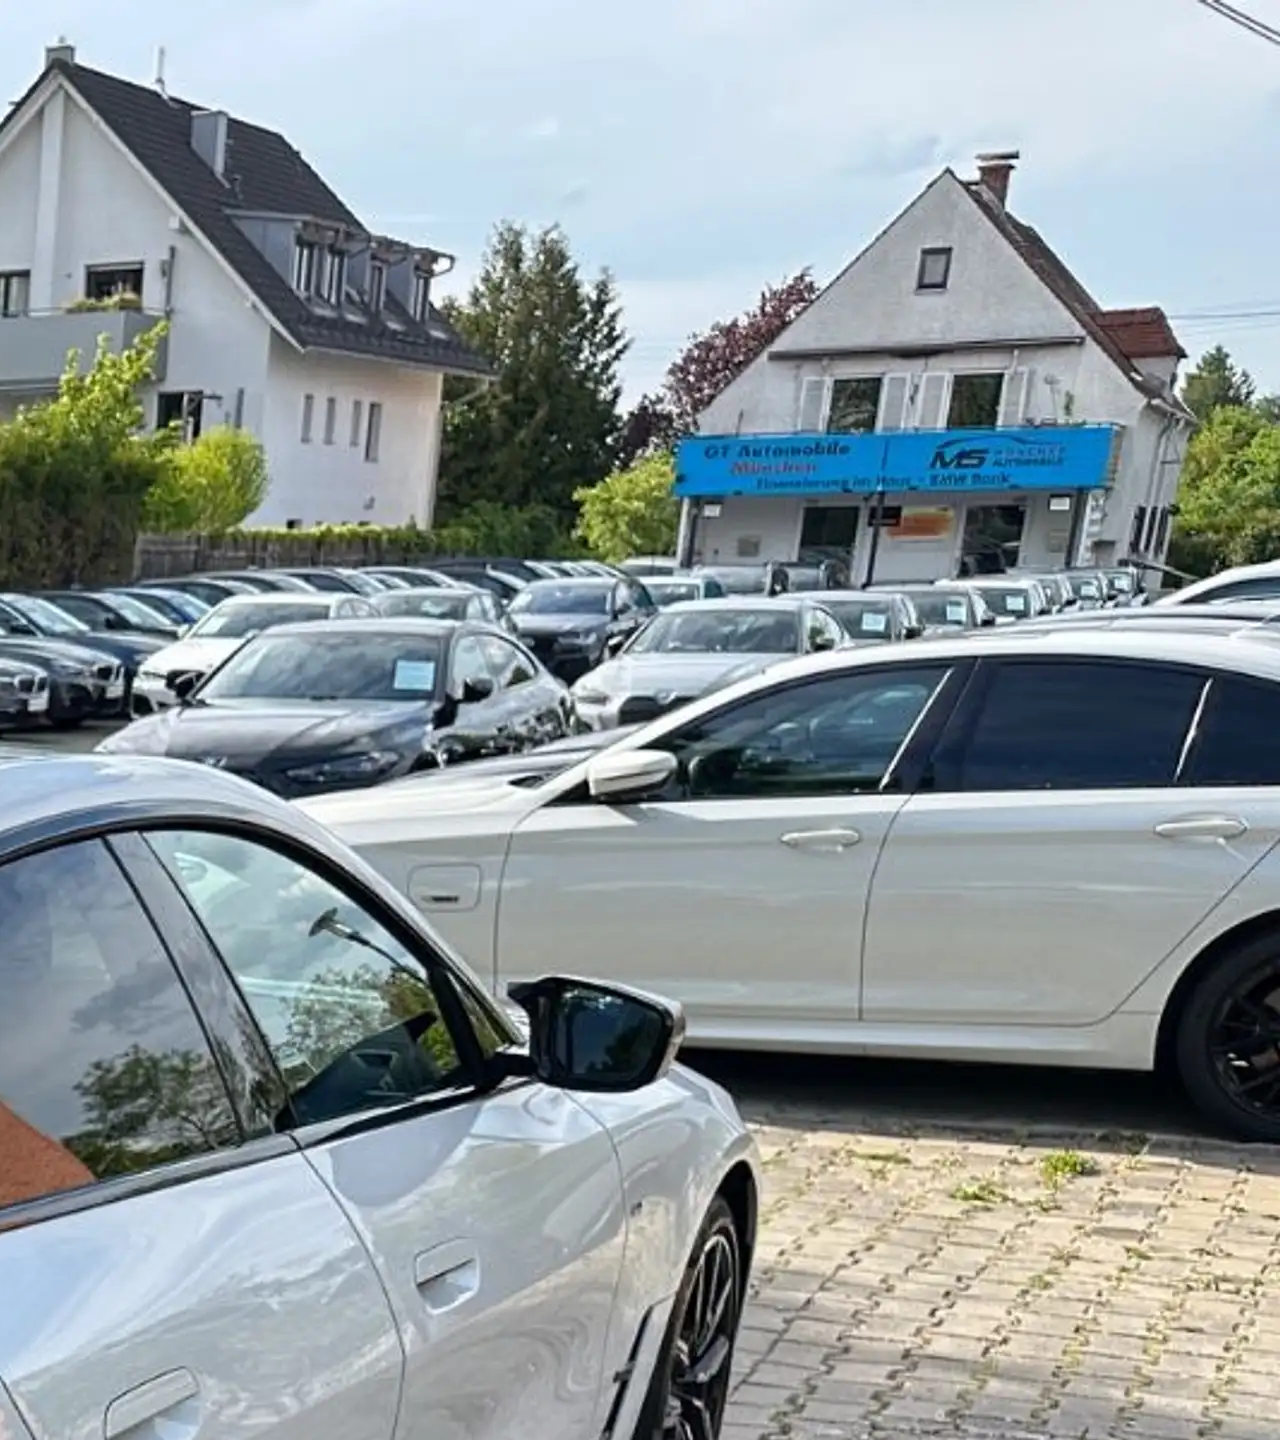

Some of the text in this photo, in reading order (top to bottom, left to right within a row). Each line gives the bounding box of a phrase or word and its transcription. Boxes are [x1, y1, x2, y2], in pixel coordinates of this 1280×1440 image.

[737, 441, 851, 458] Automobile
[930, 449, 990, 469] MS
[970, 472, 1012, 486] Bank
